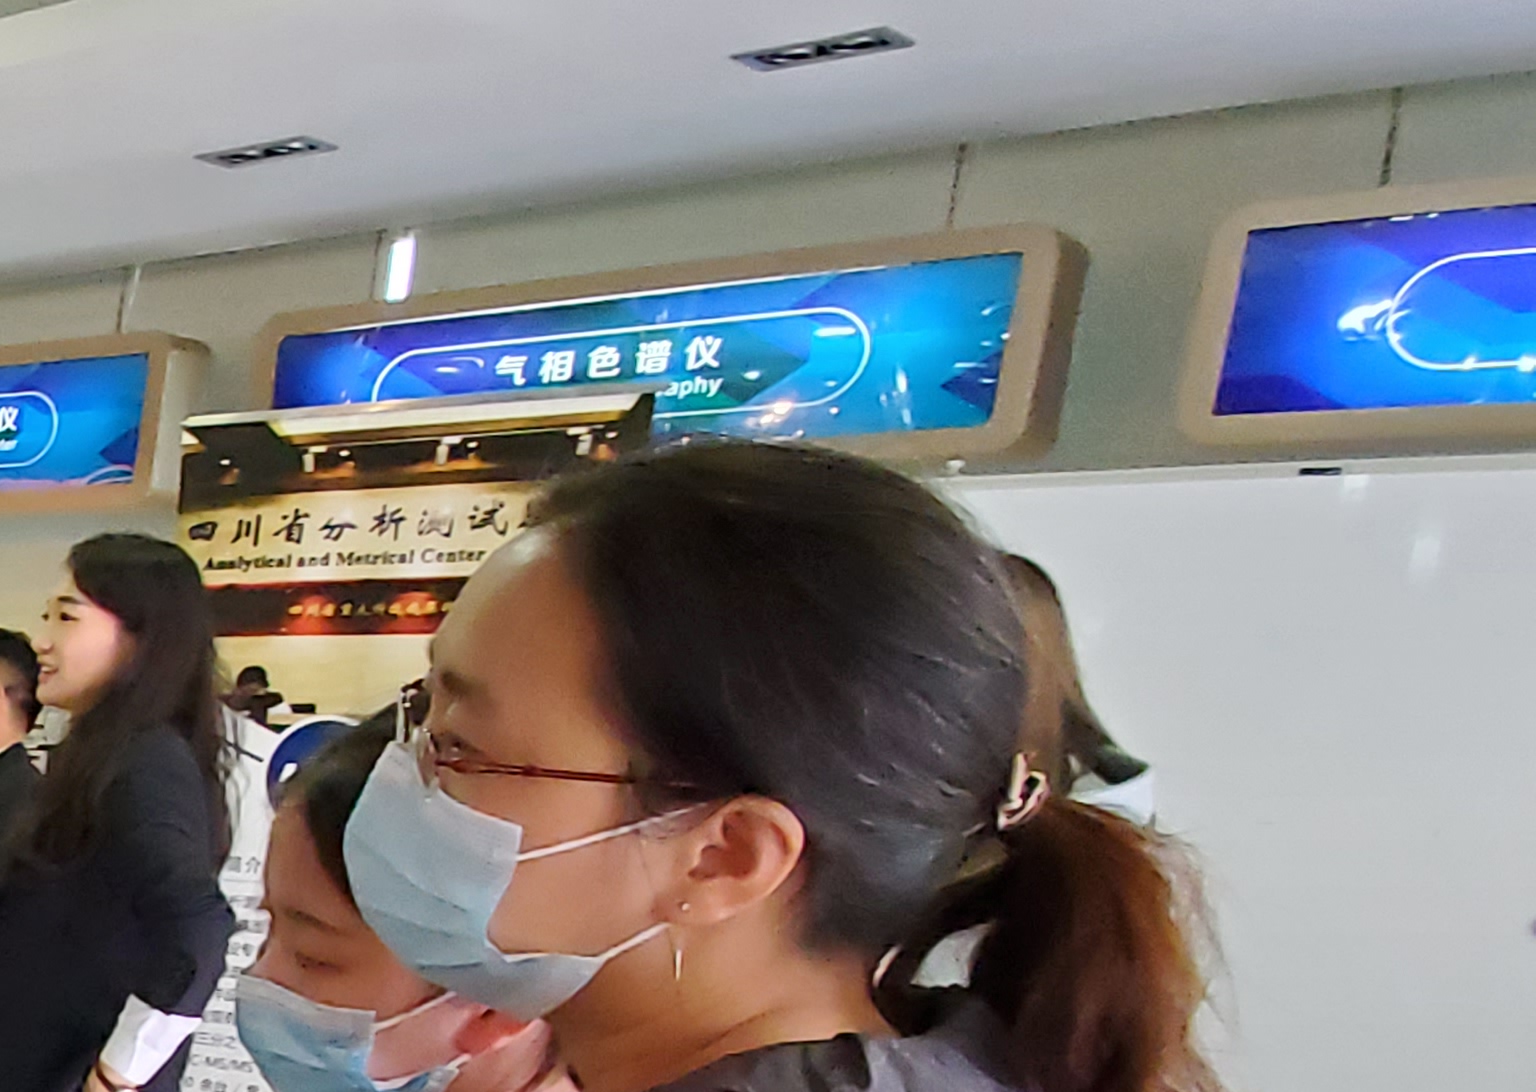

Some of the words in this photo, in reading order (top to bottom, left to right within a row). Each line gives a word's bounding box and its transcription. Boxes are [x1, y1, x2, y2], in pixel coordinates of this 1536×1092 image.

[495, 335, 724, 386] 气相色谱仪
[187, 498, 550, 547] 四川省分析测试
[203, 553, 292, 571] Analytical
[297, 553, 330, 568] and
[336, 549, 415, 567] Metrical
[421, 548, 487, 565] Center
